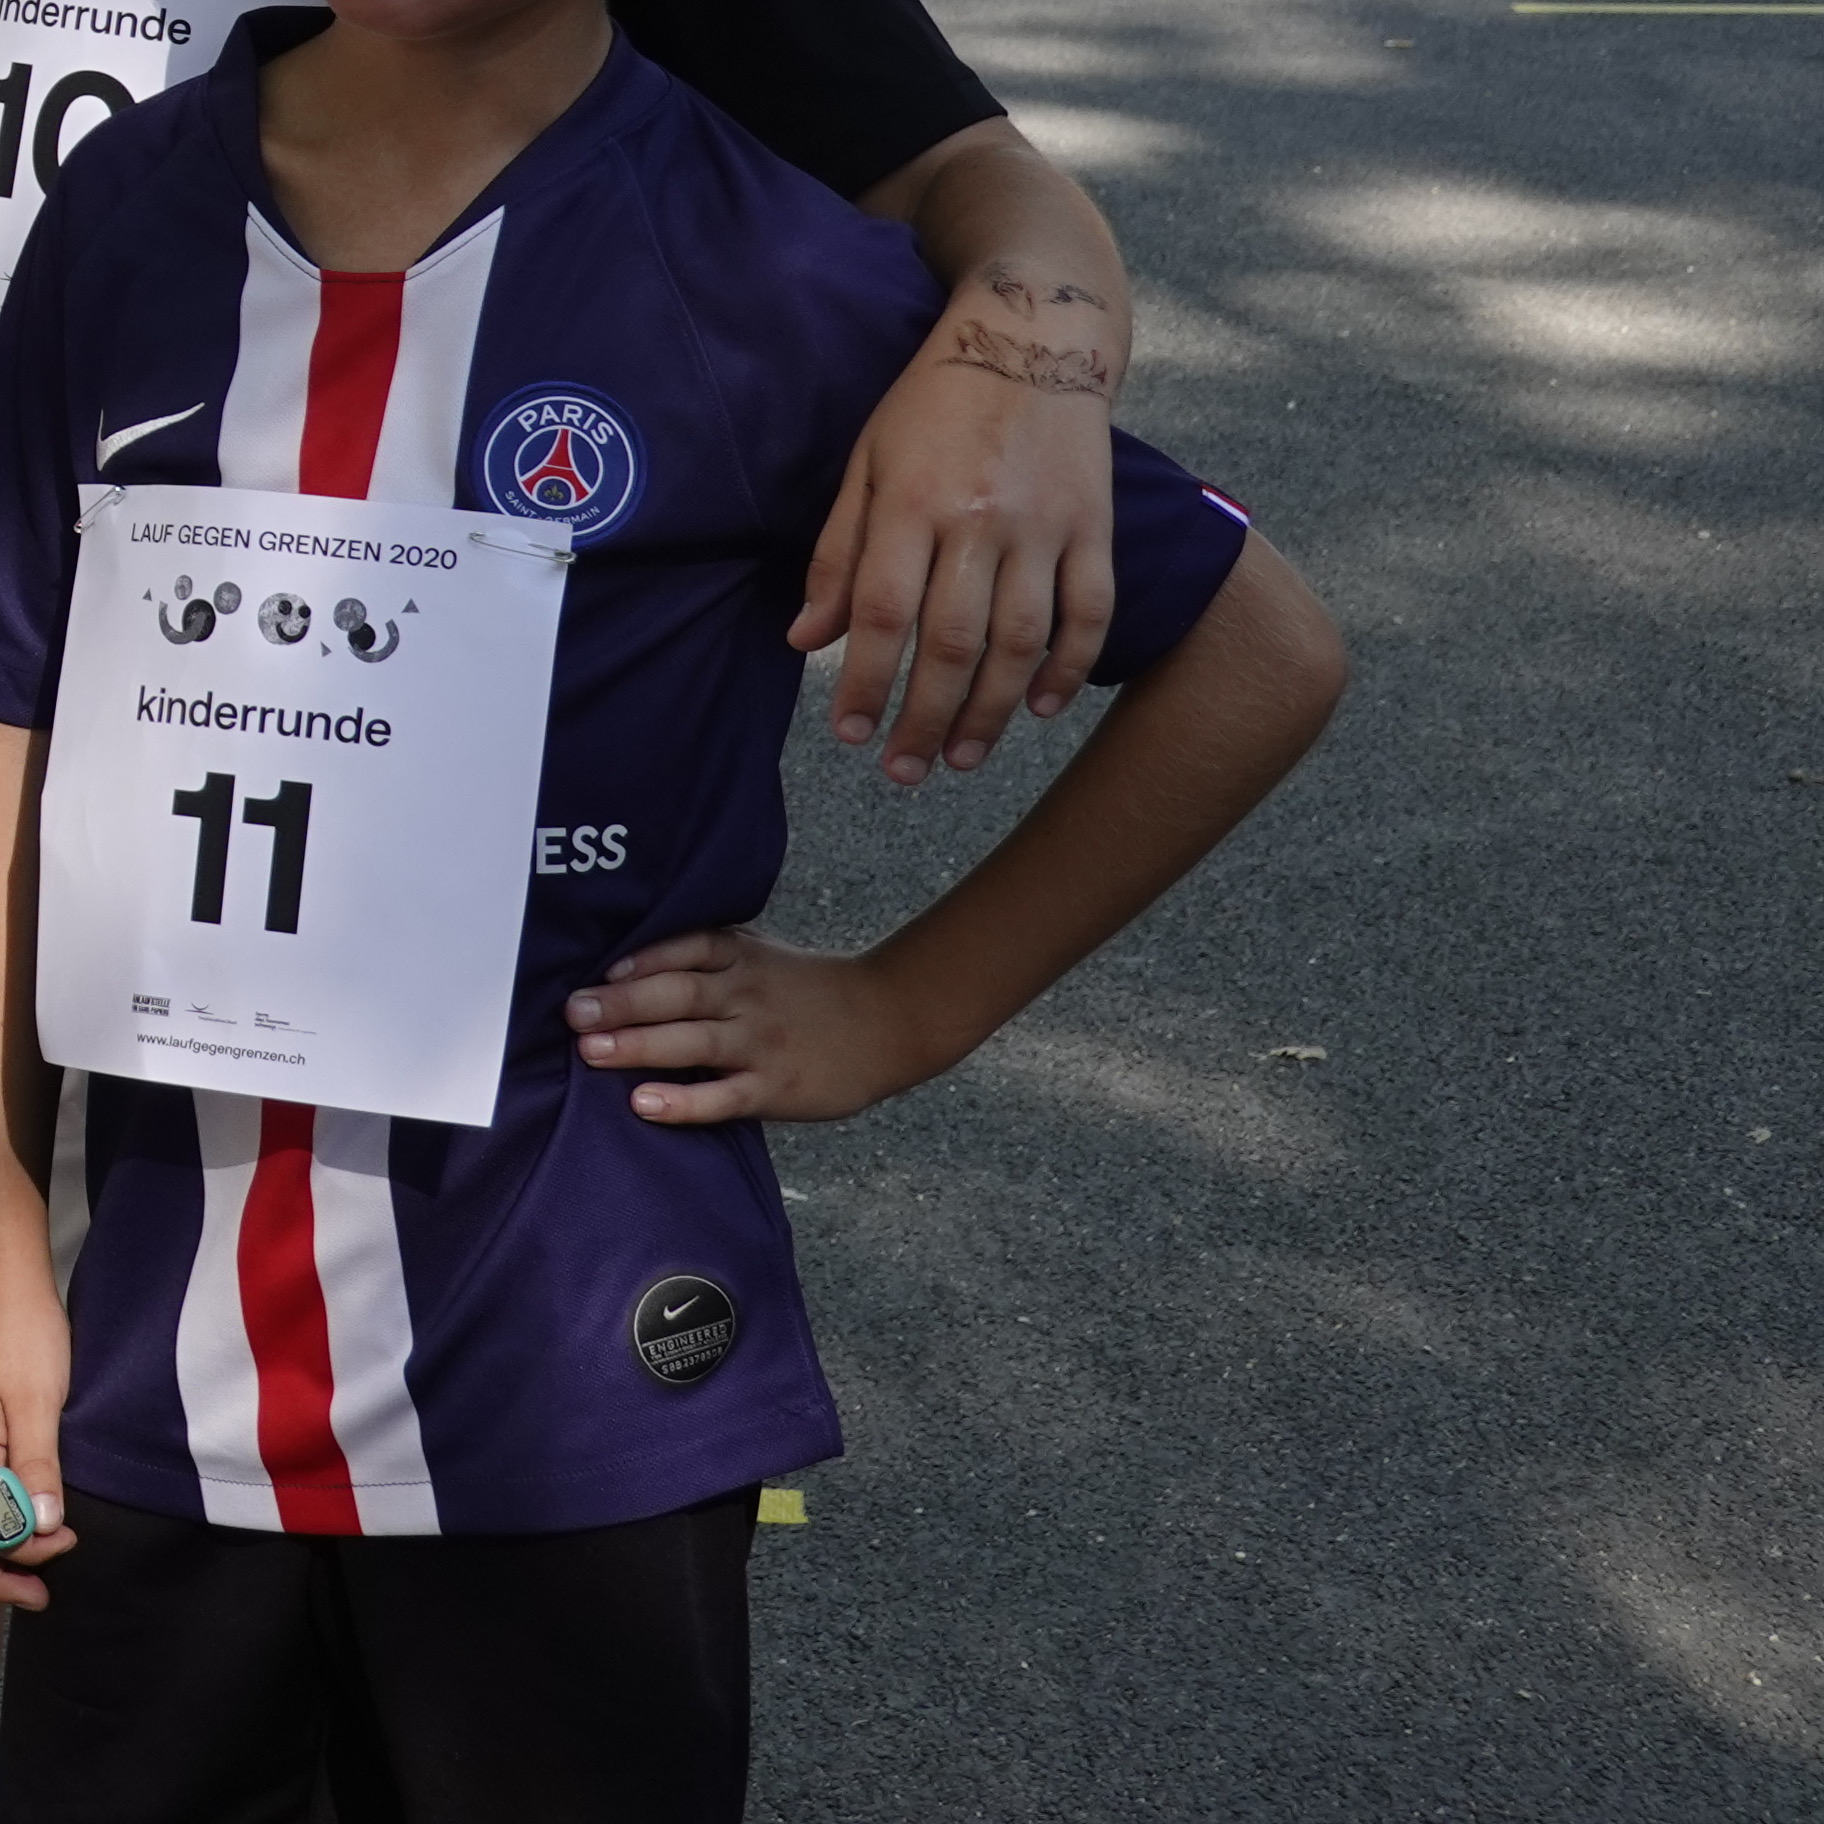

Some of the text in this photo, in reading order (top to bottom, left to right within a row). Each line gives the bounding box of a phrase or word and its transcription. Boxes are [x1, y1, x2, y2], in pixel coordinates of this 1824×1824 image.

[517, 403, 614, 444] PARIS
[131, 523, 458, 570] LAUF GEGEN GRENZEN 2020
[137, 686, 392, 746] kinderrunde
[172, 772, 313, 935] 11
[136, 1032, 306, 1065] www.laufgegengrenzen.ch
[649, 1324, 728, 1356] ENGINEERED
